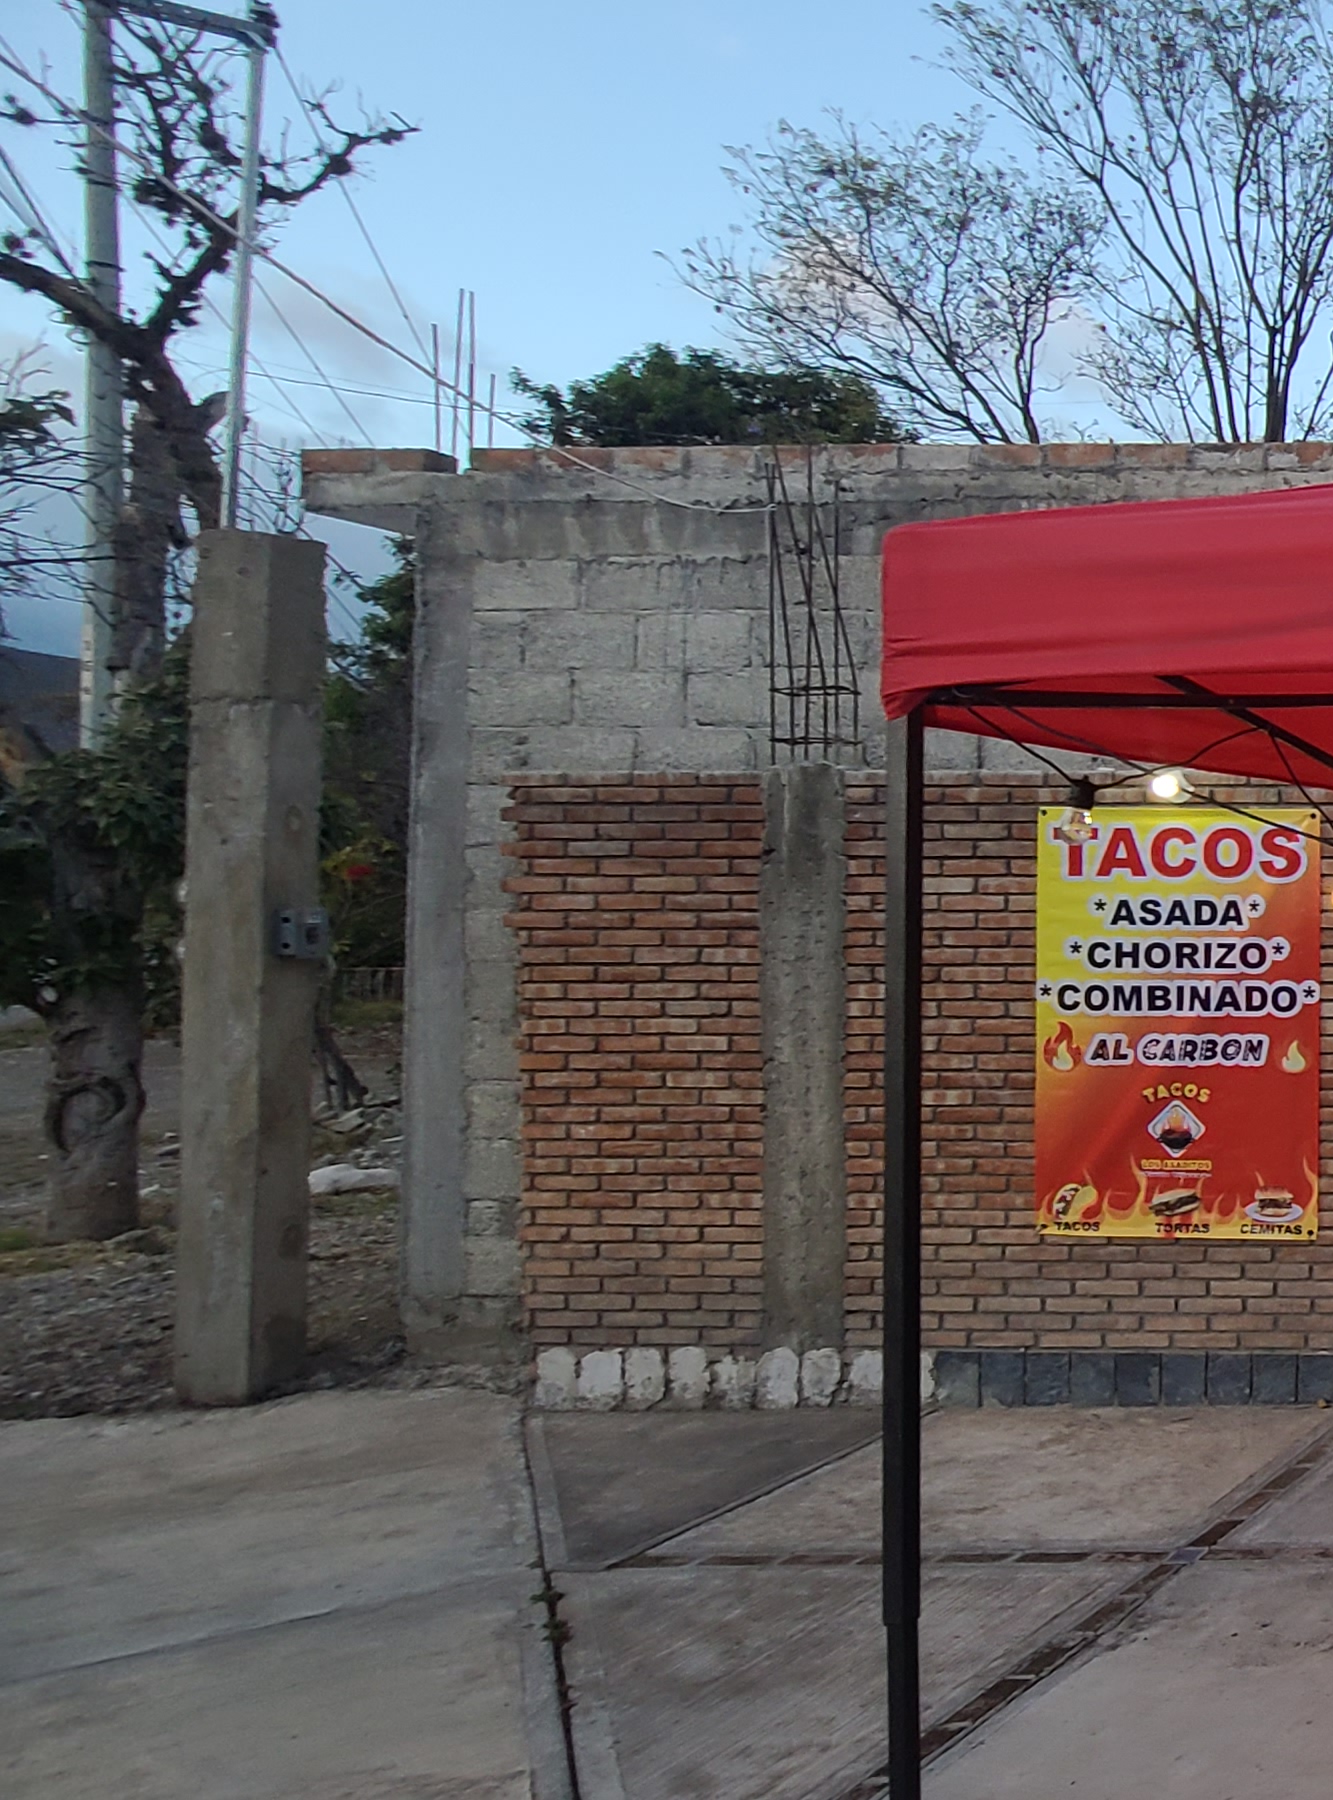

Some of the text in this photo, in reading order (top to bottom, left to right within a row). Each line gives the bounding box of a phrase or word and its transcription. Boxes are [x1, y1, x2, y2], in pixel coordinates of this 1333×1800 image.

[1053, 828, 1303, 878] TACOS
[1090, 1038, 1265, 1062] AL CARBON
[1142, 1082, 1211, 1103] TACOS
[1054, 1221, 1100, 1232] TACOS
[1155, 1223, 1210, 1234] TORTAS
[1240, 1224, 1303, 1235] CEMITAS
